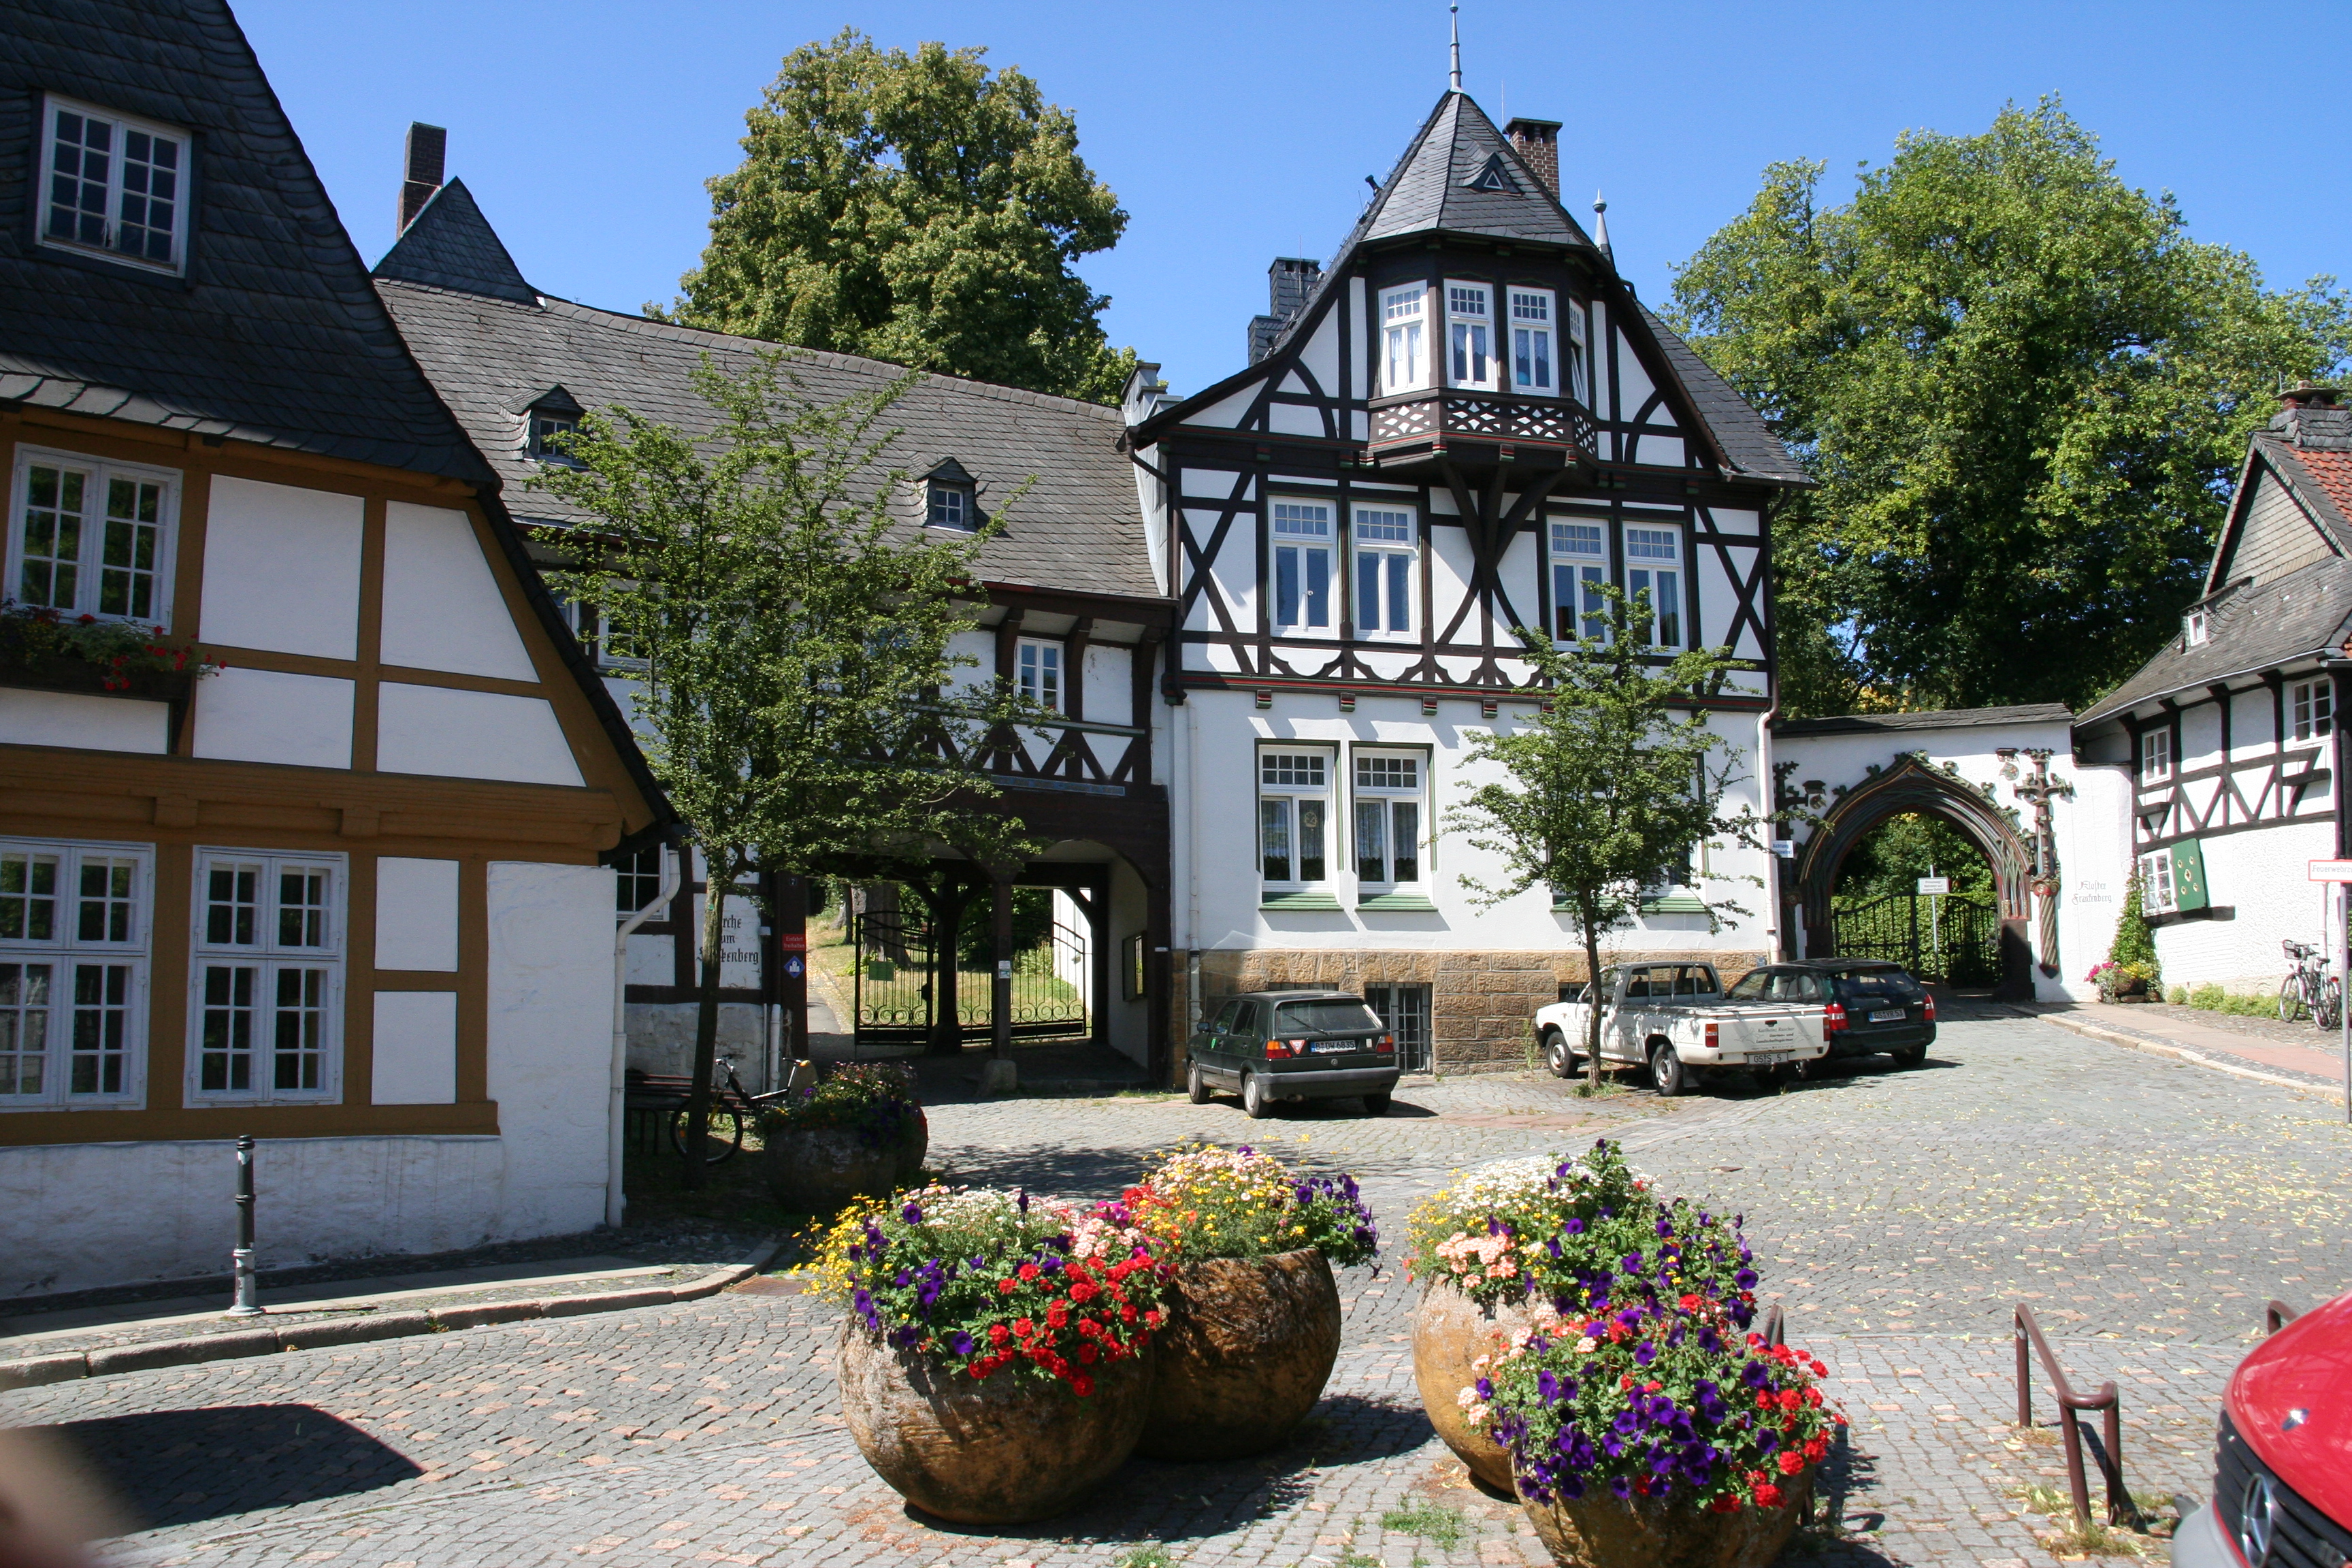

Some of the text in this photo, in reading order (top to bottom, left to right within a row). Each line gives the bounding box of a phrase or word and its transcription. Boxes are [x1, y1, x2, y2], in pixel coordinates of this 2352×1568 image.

[722, 915, 742, 930] rche
[721, 935, 736, 944] um
[696, 947, 759, 965] kenberg
